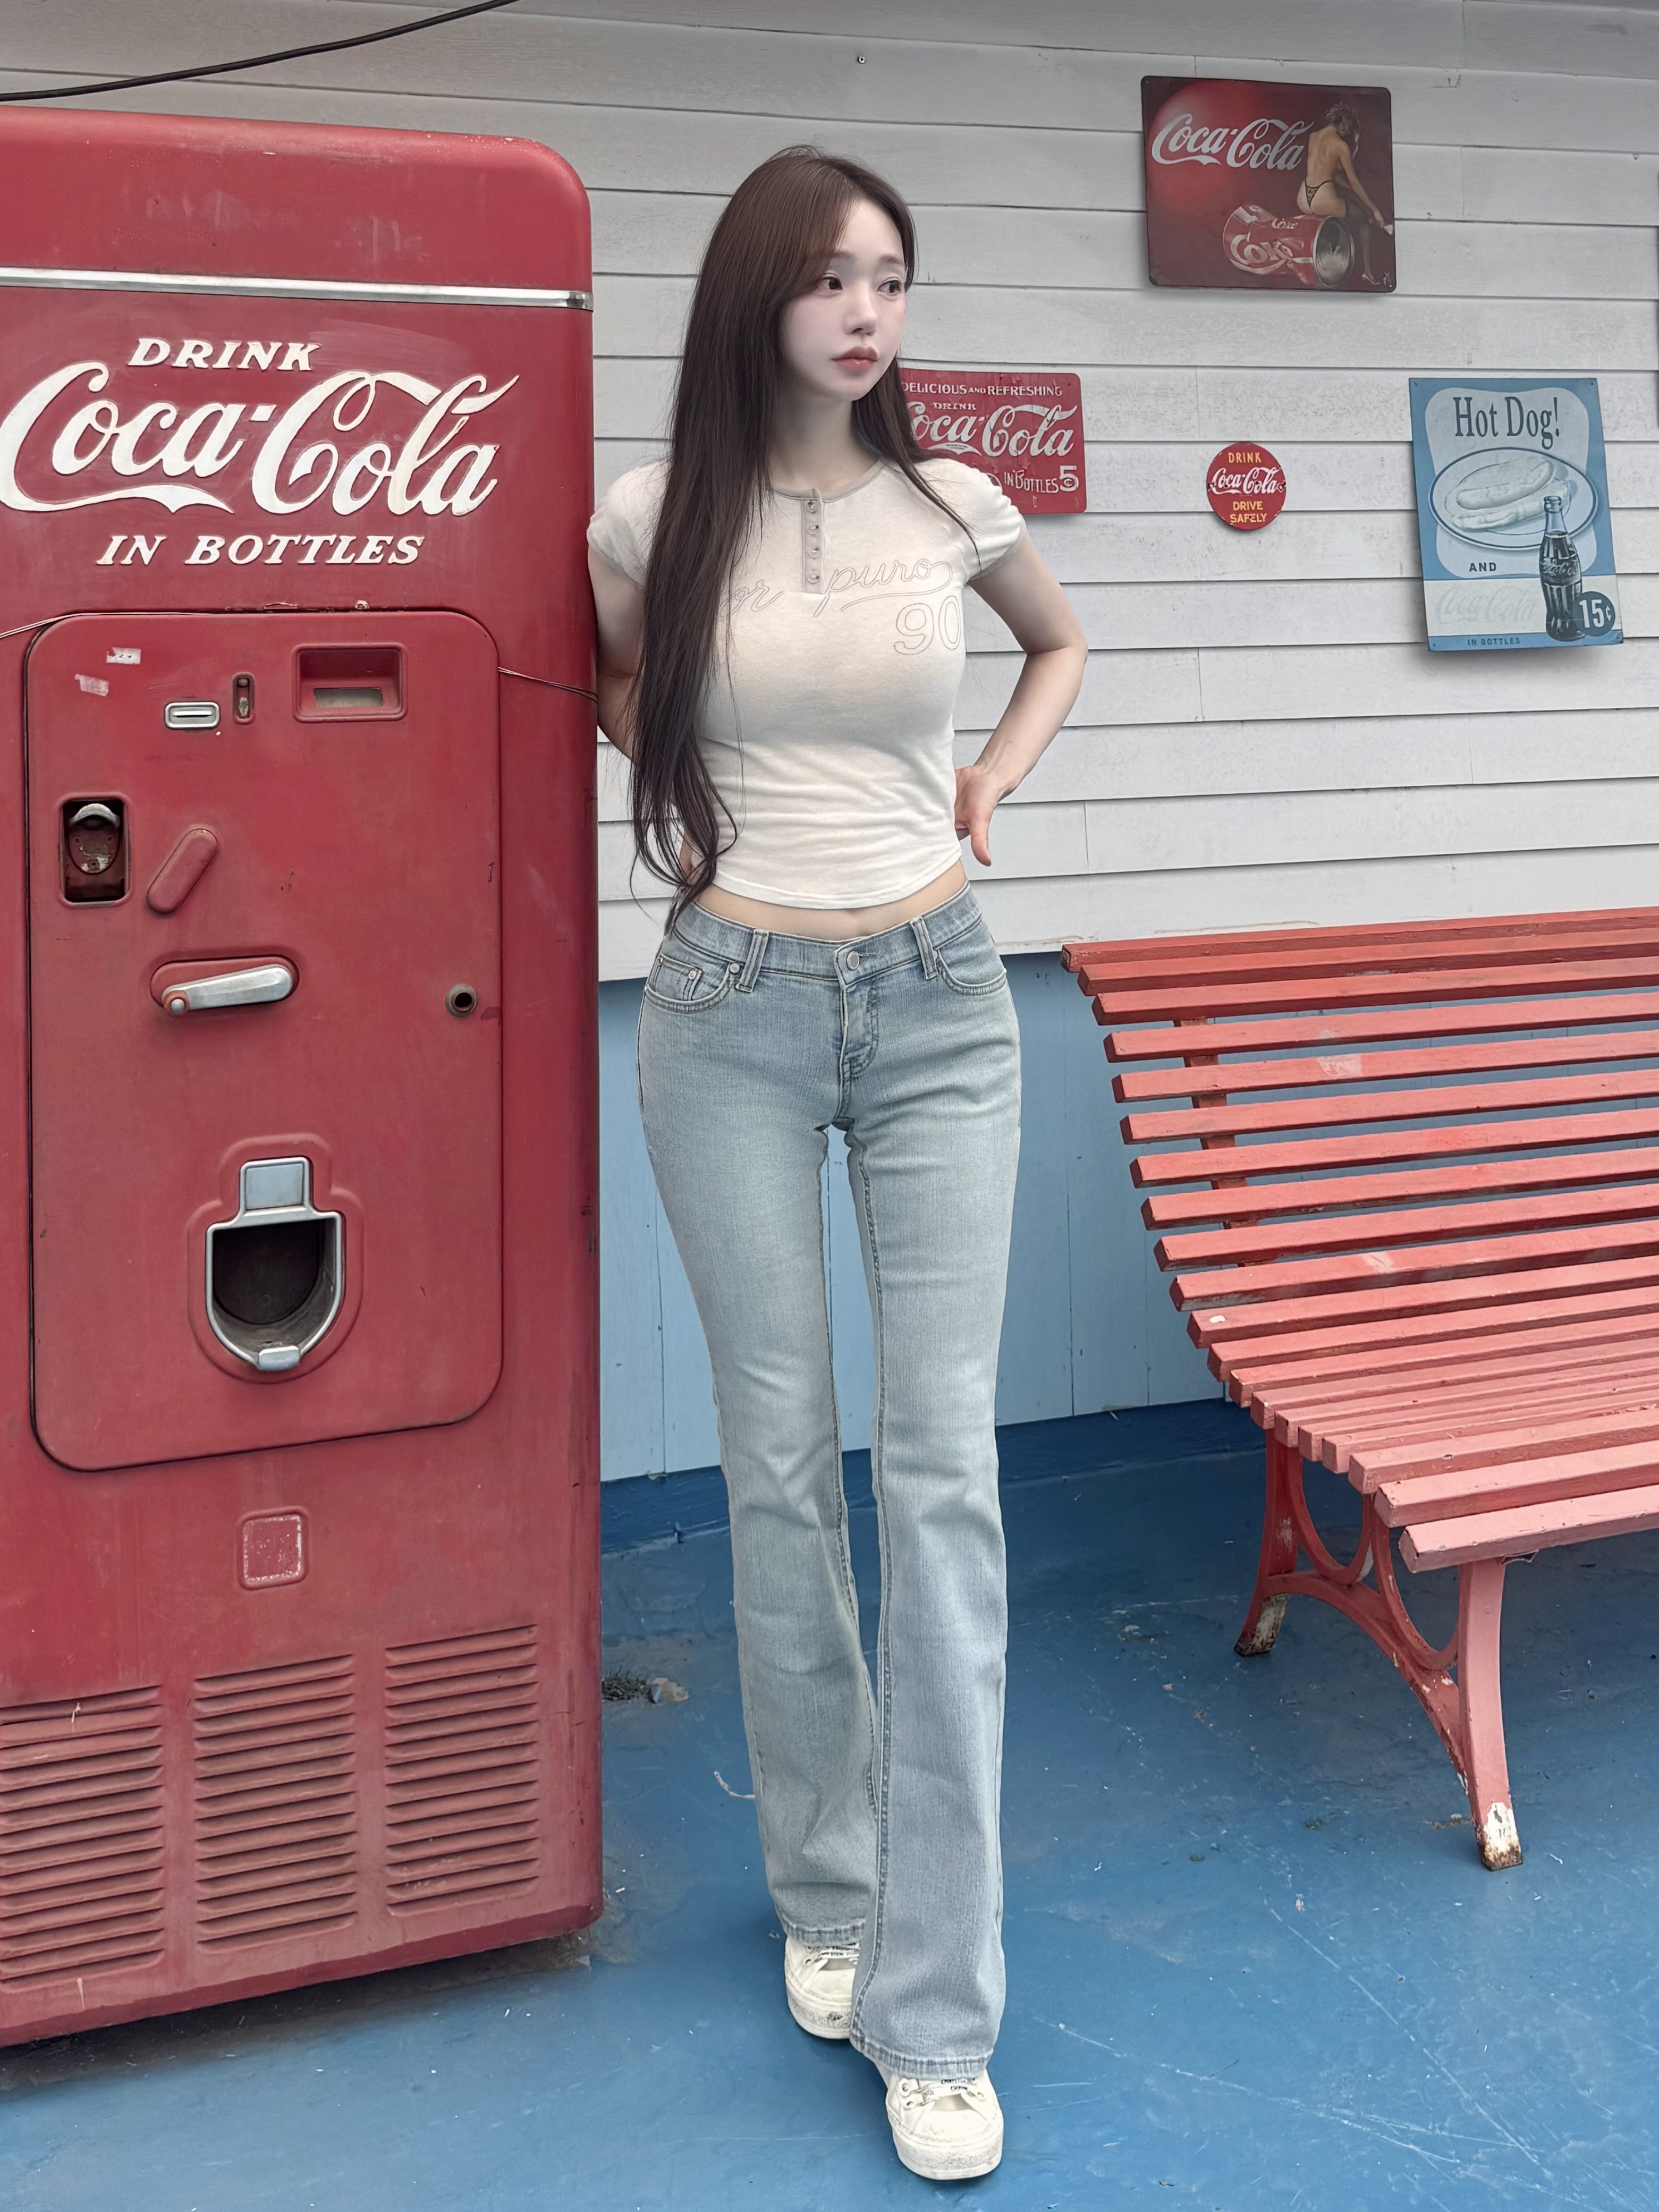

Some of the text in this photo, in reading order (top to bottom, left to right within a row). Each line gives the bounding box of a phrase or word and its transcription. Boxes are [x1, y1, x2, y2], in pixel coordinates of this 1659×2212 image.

[1152, 113, 1314, 170] Coca-Cola
[128, 338, 320, 371] DRINK
[988, 386, 1062, 396] REFRESHING
[932, 402, 977, 411] DRINK
[1453, 396, 1560, 450] Hot Dog!
[0, 361, 519, 515] Coca-Cola
[1228, 452, 1262, 463] DRINK
[1004, 471, 1014, 487] IN
[1013, 470, 1059, 494] BOTTLES
[1210, 467, 1282, 495] Coca-Cola
[1230, 513, 1267, 523] SAFELY
[1233, 501, 1263, 511] DRIVE
[96, 535, 425, 566] IN BOTTLES
[1469, 562, 1497, 572] AND
[893, 596, 962, 655] 90
[1579, 599, 1612, 629] 15¢
